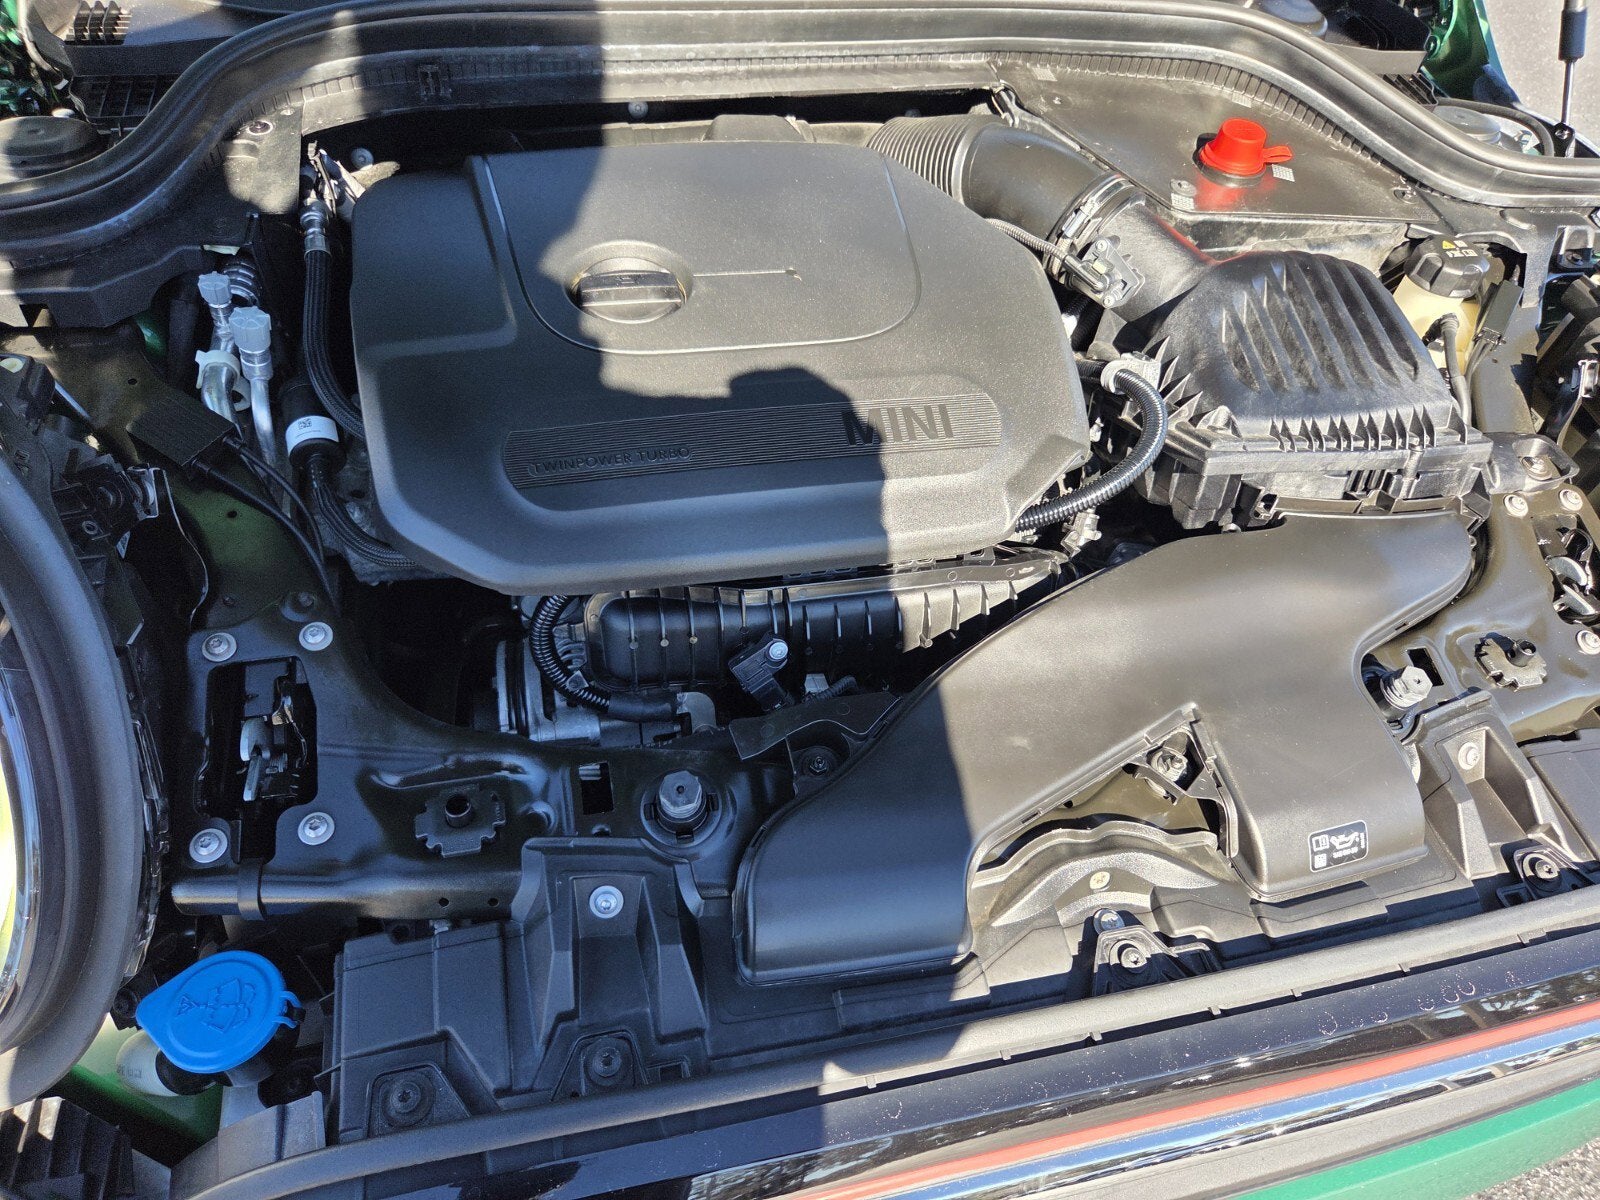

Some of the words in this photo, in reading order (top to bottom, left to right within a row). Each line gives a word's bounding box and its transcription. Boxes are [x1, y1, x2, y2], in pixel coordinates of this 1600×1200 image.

[841, 404, 954, 445] MINI
[531, 453, 632, 474] TWINPOWER
[638, 448, 691, 462] TURBO
